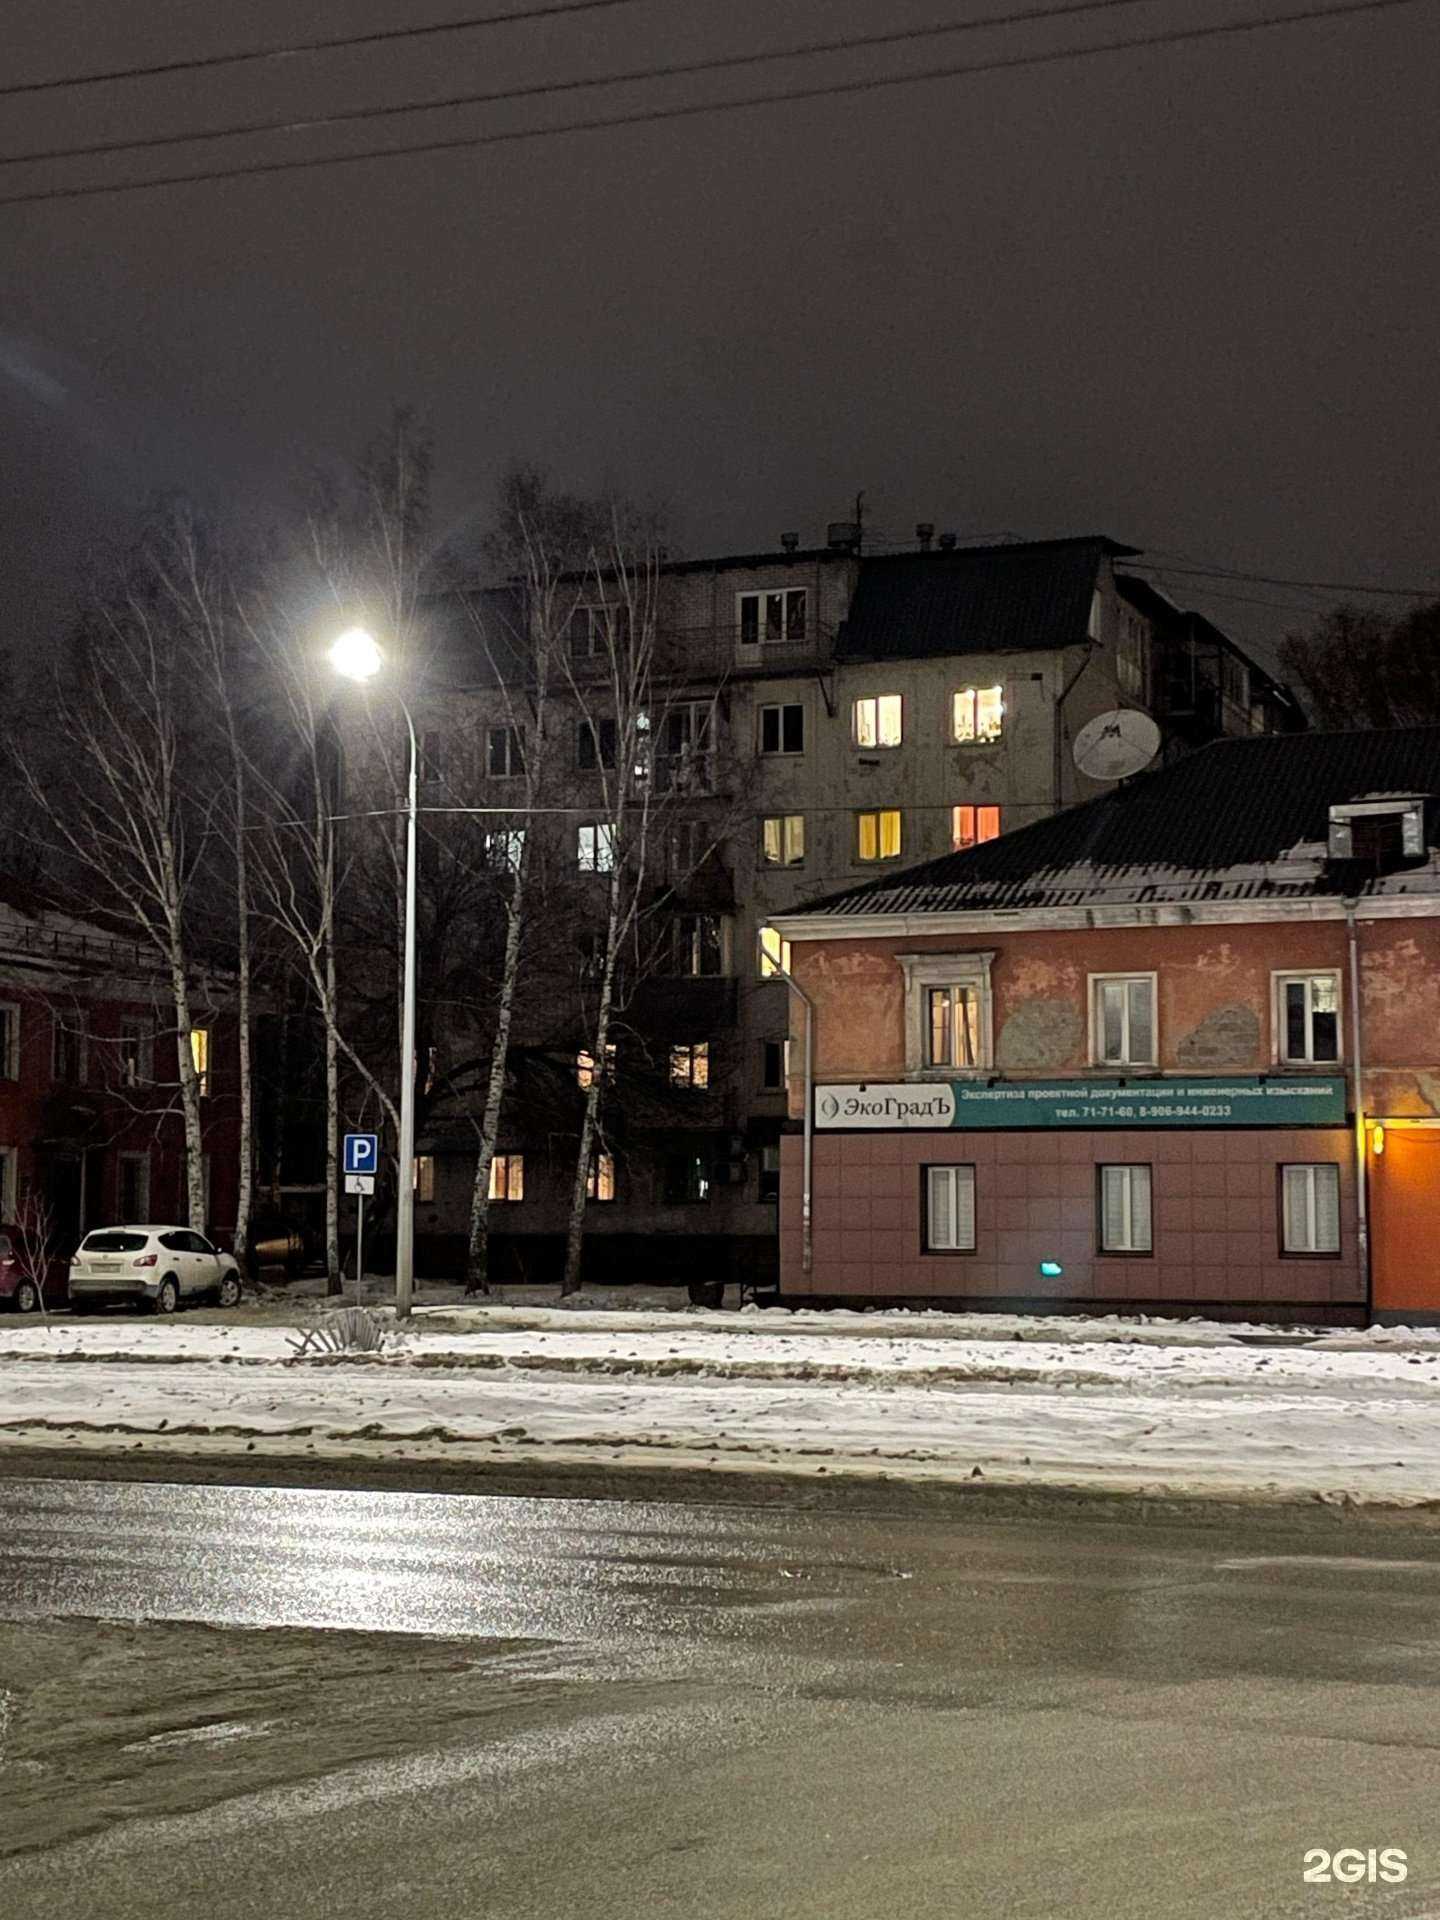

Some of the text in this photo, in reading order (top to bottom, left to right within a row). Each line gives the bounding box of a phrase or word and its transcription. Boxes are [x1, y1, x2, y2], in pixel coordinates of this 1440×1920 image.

[960, 1088, 1025, 1100] Экспертиза
[1027, 1087, 1088, 1100] проектной
[1090, 1088, 1174, 1099] документации
[1176, 1088, 1185, 1097] и
[1187, 1087, 1264, 1099] инженерных
[843, 1097, 950, 1119] ЭкоГрадЪ
[1055, 1108, 1080, 1118] тел.
[353, 1139, 371, 1168] P
